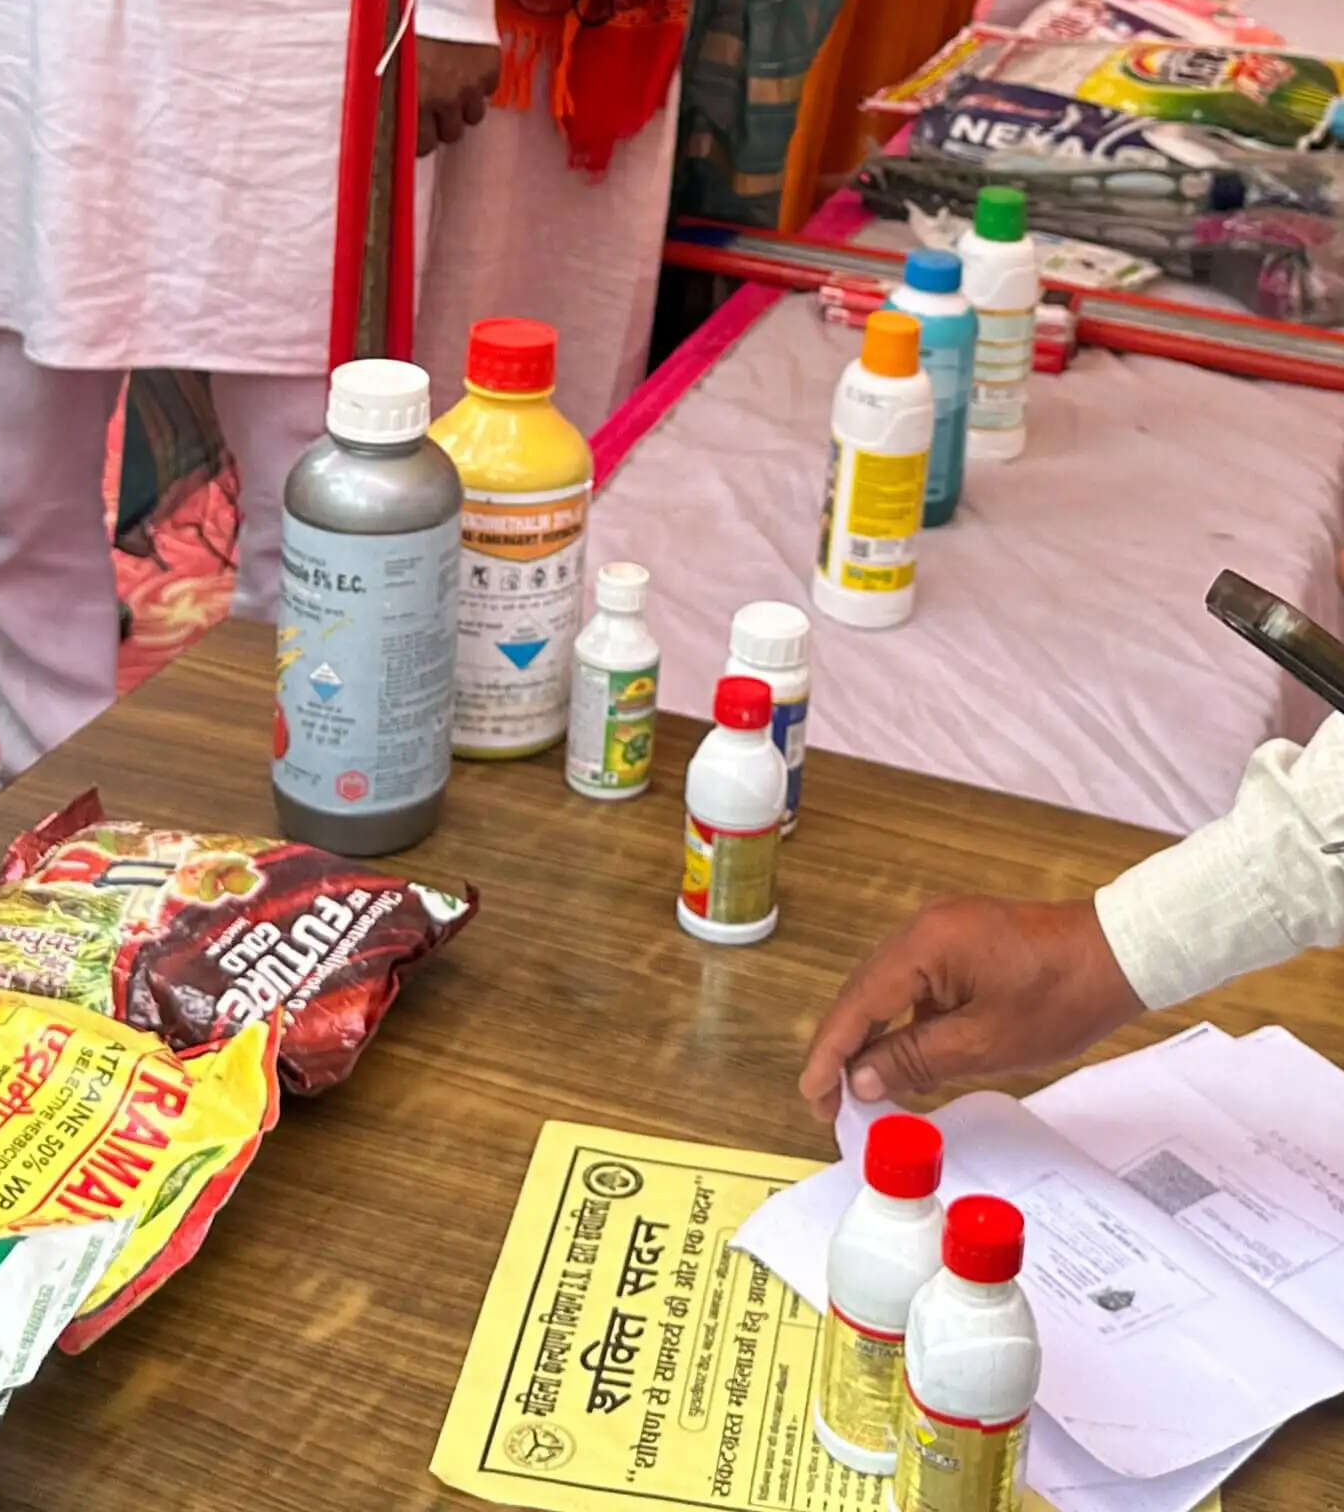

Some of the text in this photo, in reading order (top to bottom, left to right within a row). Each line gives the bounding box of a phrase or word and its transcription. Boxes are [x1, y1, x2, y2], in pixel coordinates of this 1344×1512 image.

[215, 895, 353, 1027] FUTURE
[217, 921, 282, 976] GOLD
[38, 1048, 93, 1120] SELECTIVE
[56, 1047, 124, 1136] ATRAINE
[21, 1134, 64, 1174] 50%
[683, 1228, 705, 1253] एक
[671, 1259, 697, 1288] ओर
[580, 1216, 668, 1411] शक्ति सदन
[665, 1295, 690, 1315] की
[737, 1309, 768, 1331] हेतु
[643, 1387, 670, 1404] से
[726, 1336, 757, 1404] महिलाओं
[709, 1412, 744, 1496] संकटग्रस्त
